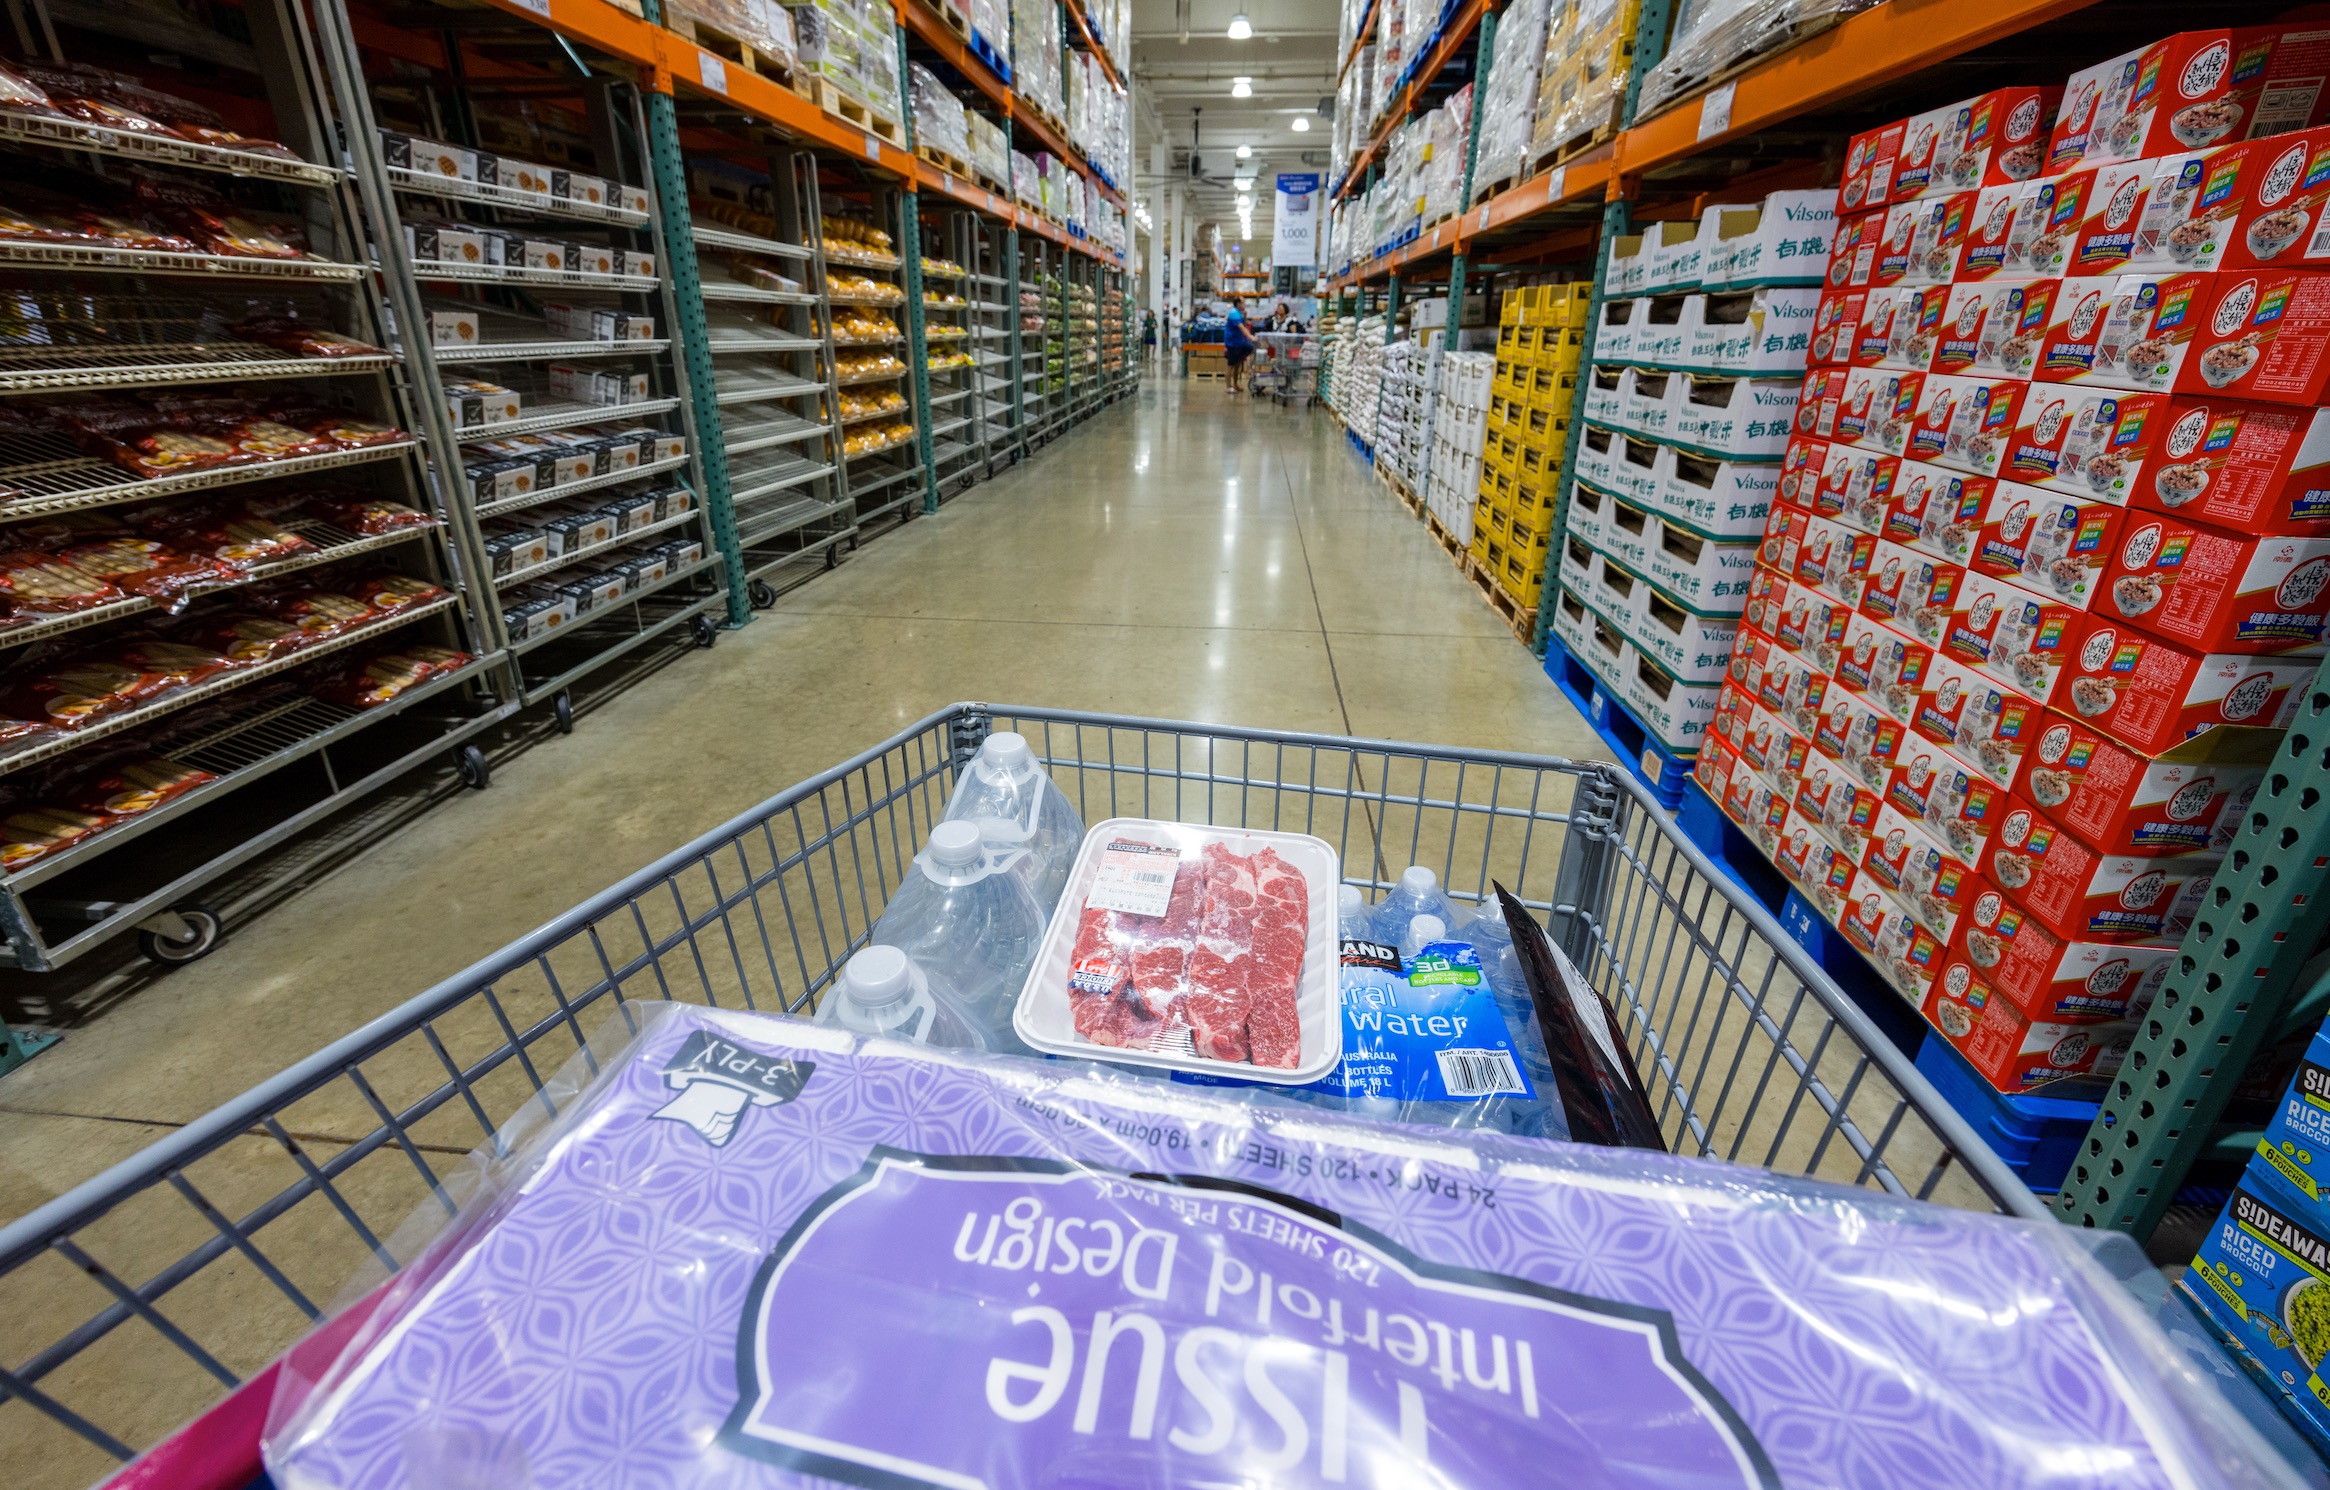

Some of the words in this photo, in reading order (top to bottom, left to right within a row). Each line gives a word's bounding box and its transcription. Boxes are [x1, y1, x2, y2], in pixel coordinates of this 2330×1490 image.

[1785, 201, 1834, 221] Vilson
[1282, 228, 1307, 239] 1,000
[2085, 232, 2133, 247] 健康多穀飯
[1772, 300, 1818, 319] Vilson
[2051, 343, 2094, 356] 健康多穀飯
[1754, 388, 1799, 406] Vilson
[1735, 473, 1778, 490] Vilson
[2249, 612, 2321, 626] 健康多穀飯
[2143, 822, 2207, 836] 健康多穀飯
[1073, 980, 1109, 993] U.S.D.A.
[1076, 974, 1111, 984] CHOICE
[1348, 1011, 1465, 1037] Water
[691, 1039, 789, 1085] 3-PLY
[1348, 1065, 1393, 1076] BOTTLES
[1194, 1075, 1218, 1084] MADE
[1369, 1078, 1382, 1086] 18
[1384, 1078, 1392, 1087] L
[1116, 1121, 1192, 1150] 19.0cm
[2266, 1148, 2275, 1160] 6
[1320, 1158, 1360, 1182] 120
[2273, 1158, 2309, 1190] POUCHES
[1385, 1167, 1458, 1199] PACK
[1093, 1180, 1161, 1207] PACK
[1467, 1183, 1497, 1208] 24
[1168, 1195, 1220, 1226] PER
[1227, 1206, 1329, 1259] SHEETS
[953, 1195, 1180, 1302] Design
[2222, 1223, 2276, 1270] RICED
[1332, 1246, 1382, 1288] 120
[2220, 1239, 2270, 1279] BROCCOLI
[2201, 1266, 2209, 1277] 6
[2208, 1276, 2240, 1310] POUCHES
[1206, 1251, 1540, 1418] Interfold
[2318, 1388, 2328, 1399] 6
